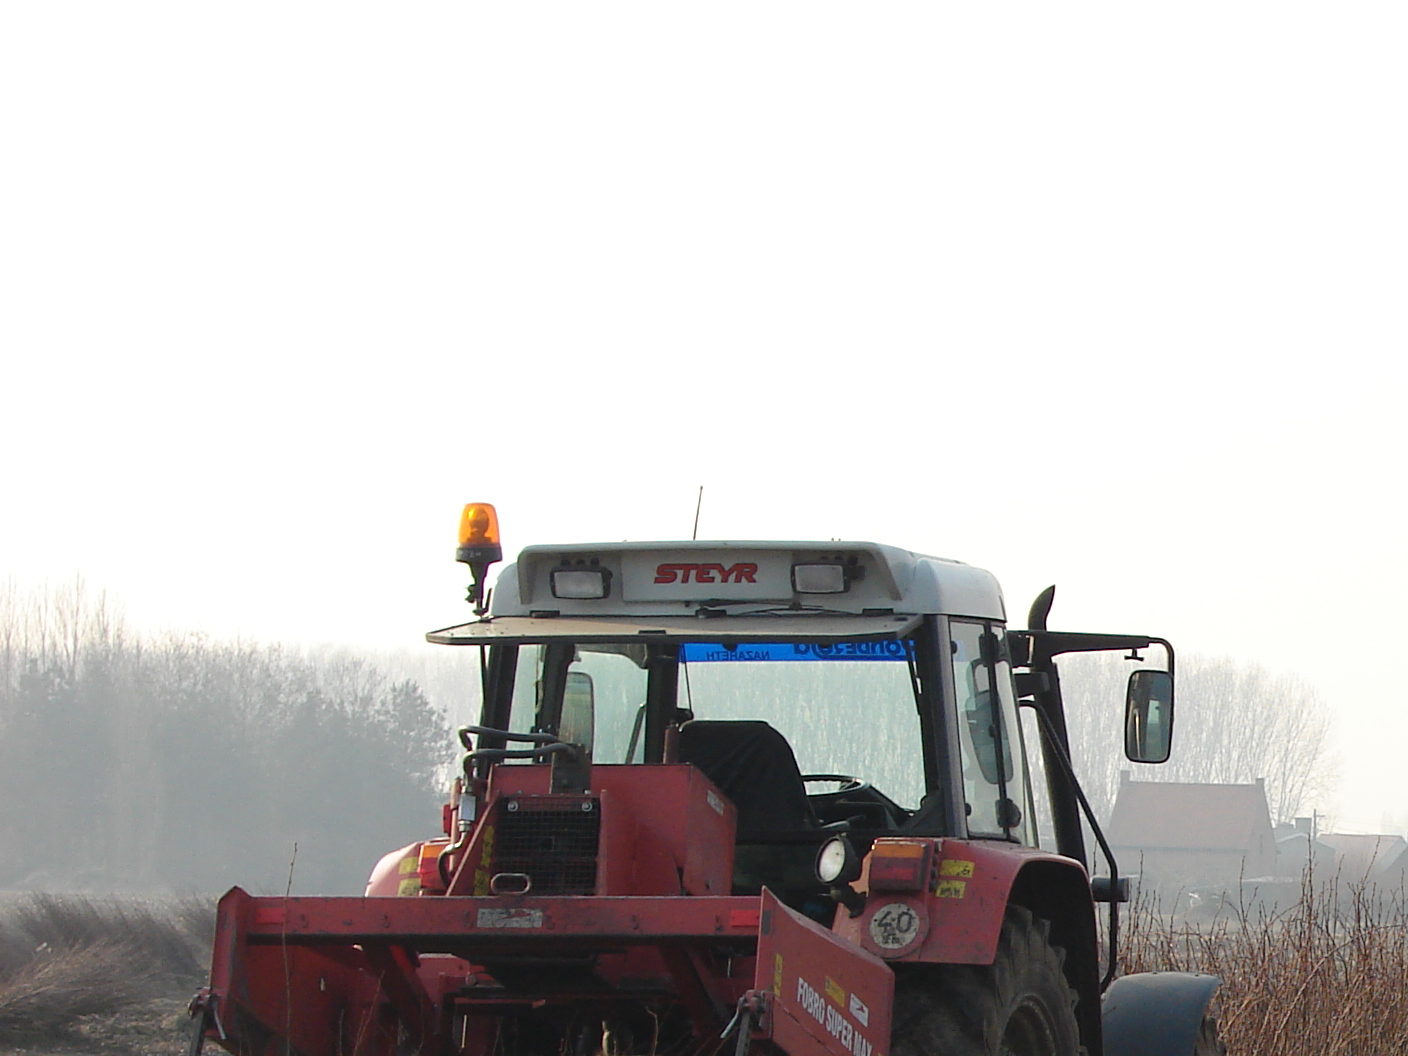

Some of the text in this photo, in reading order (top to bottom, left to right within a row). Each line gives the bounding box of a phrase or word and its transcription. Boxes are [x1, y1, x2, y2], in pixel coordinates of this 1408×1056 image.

[653, 562, 759, 584] STEYR
[877, 910, 912, 934] 40
[825, 1004, 853, 1052] SUPER
